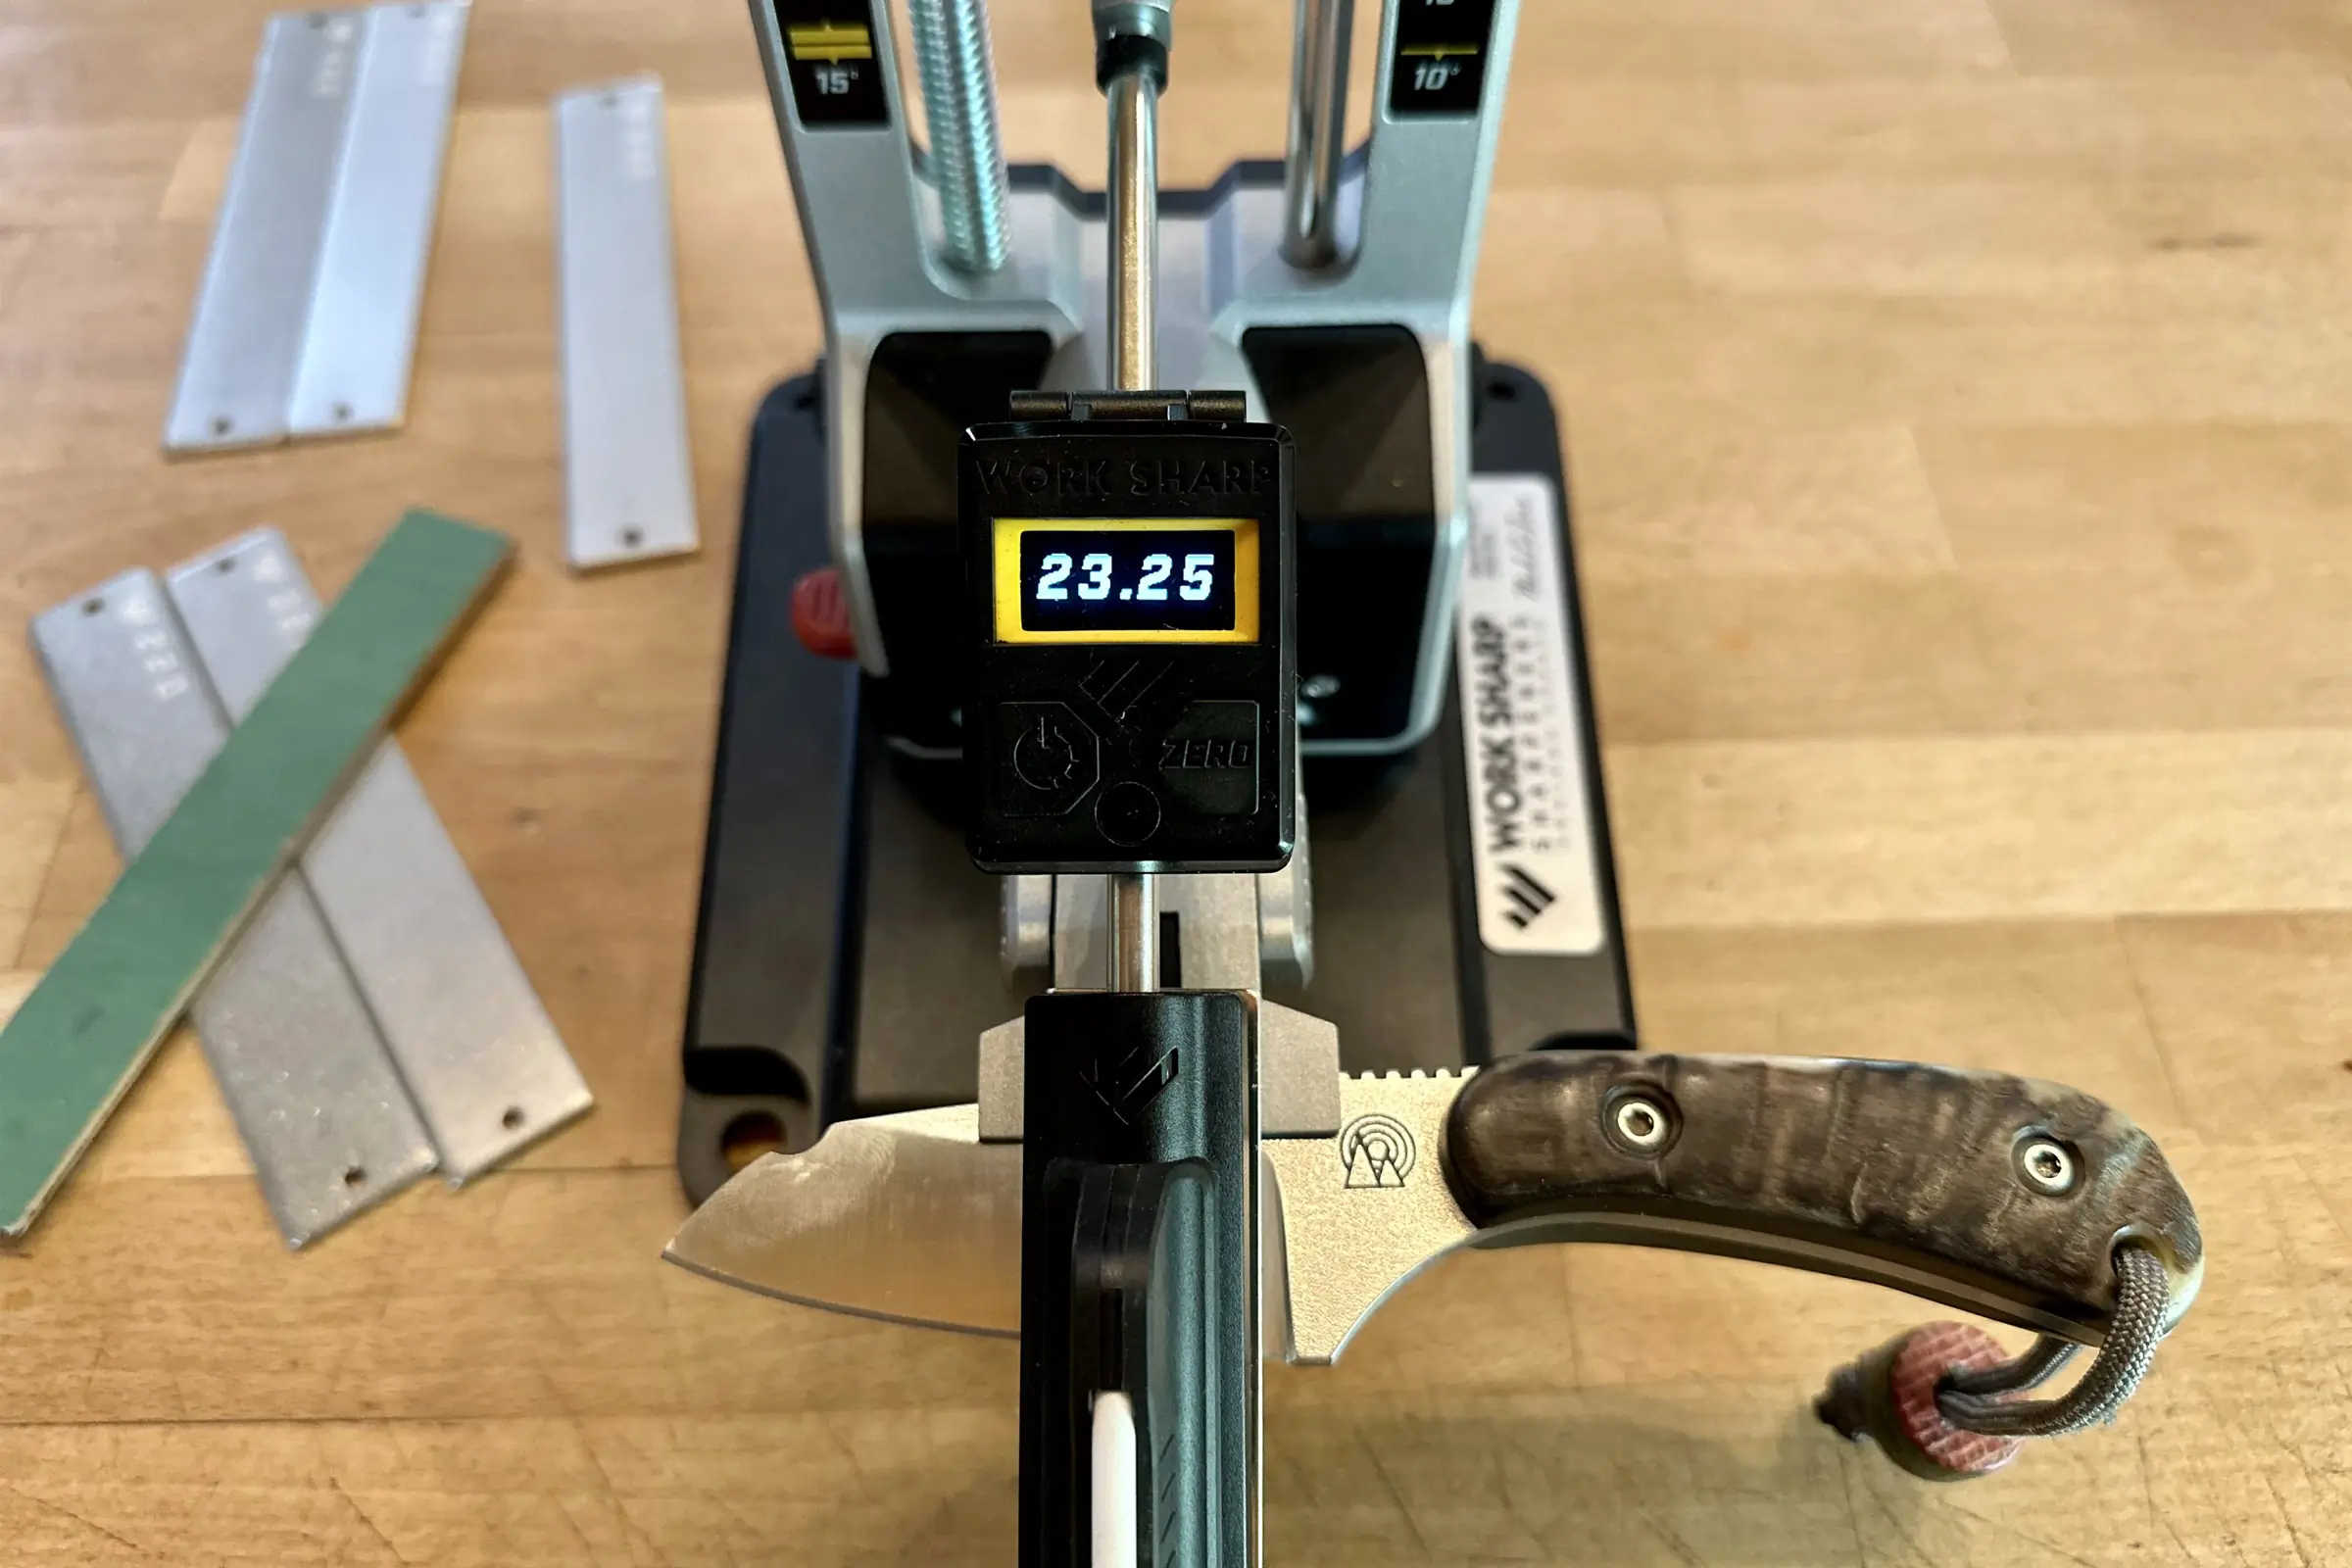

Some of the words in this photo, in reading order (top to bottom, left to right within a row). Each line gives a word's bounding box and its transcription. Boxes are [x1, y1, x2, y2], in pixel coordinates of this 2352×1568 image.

[975, 459, 1109, 497] WORK
[1128, 459, 1273, 496] SHARP
[1036, 553, 1215, 602] 23.25
[1469, 616, 1511, 727] SHARP
[1159, 738, 1253, 769] ZERO
[1479, 737, 1524, 853] WORK
